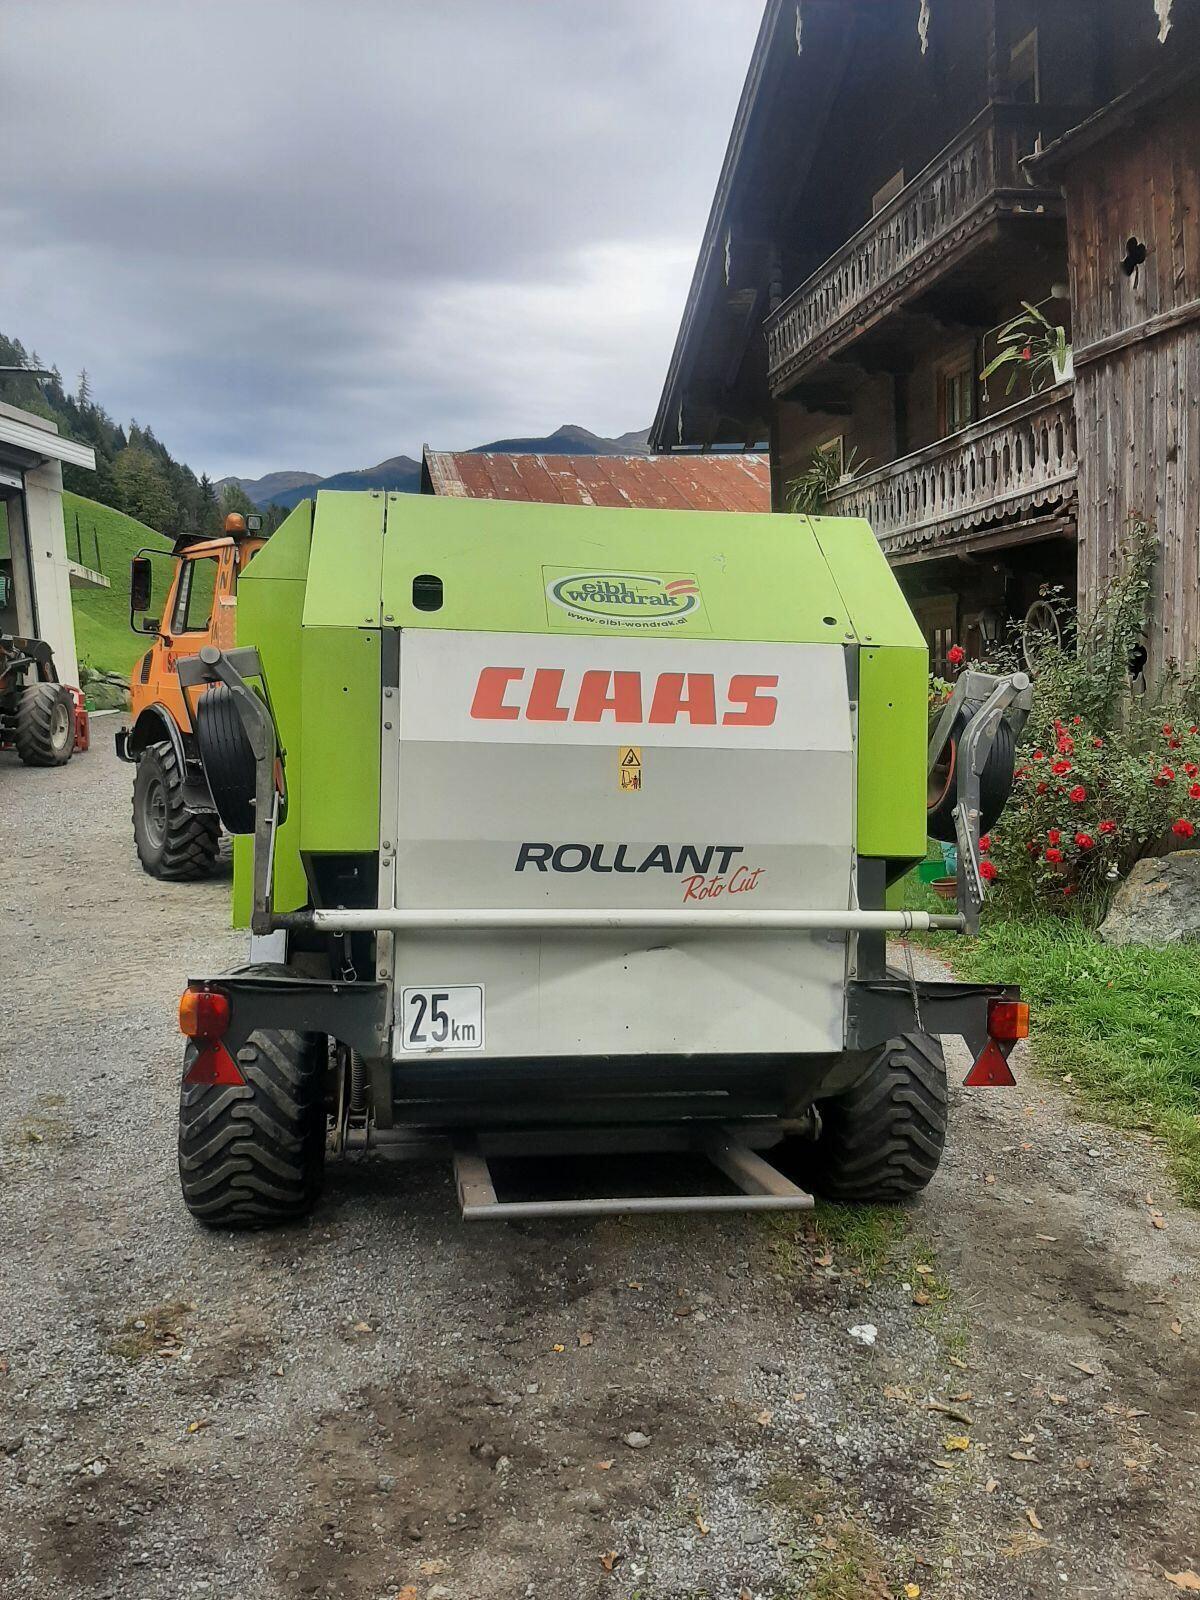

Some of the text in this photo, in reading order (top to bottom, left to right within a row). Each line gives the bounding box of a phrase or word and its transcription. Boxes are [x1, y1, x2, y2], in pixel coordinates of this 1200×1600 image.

[566, 591, 679, 606] wondrak
[581, 581, 627, 594] eibl
[470, 666, 779, 726] CLAAS
[514, 843, 744, 874] ROLLANT
[681, 866, 766, 903] Roto Cut
[409, 994, 476, 1042] 25 km
